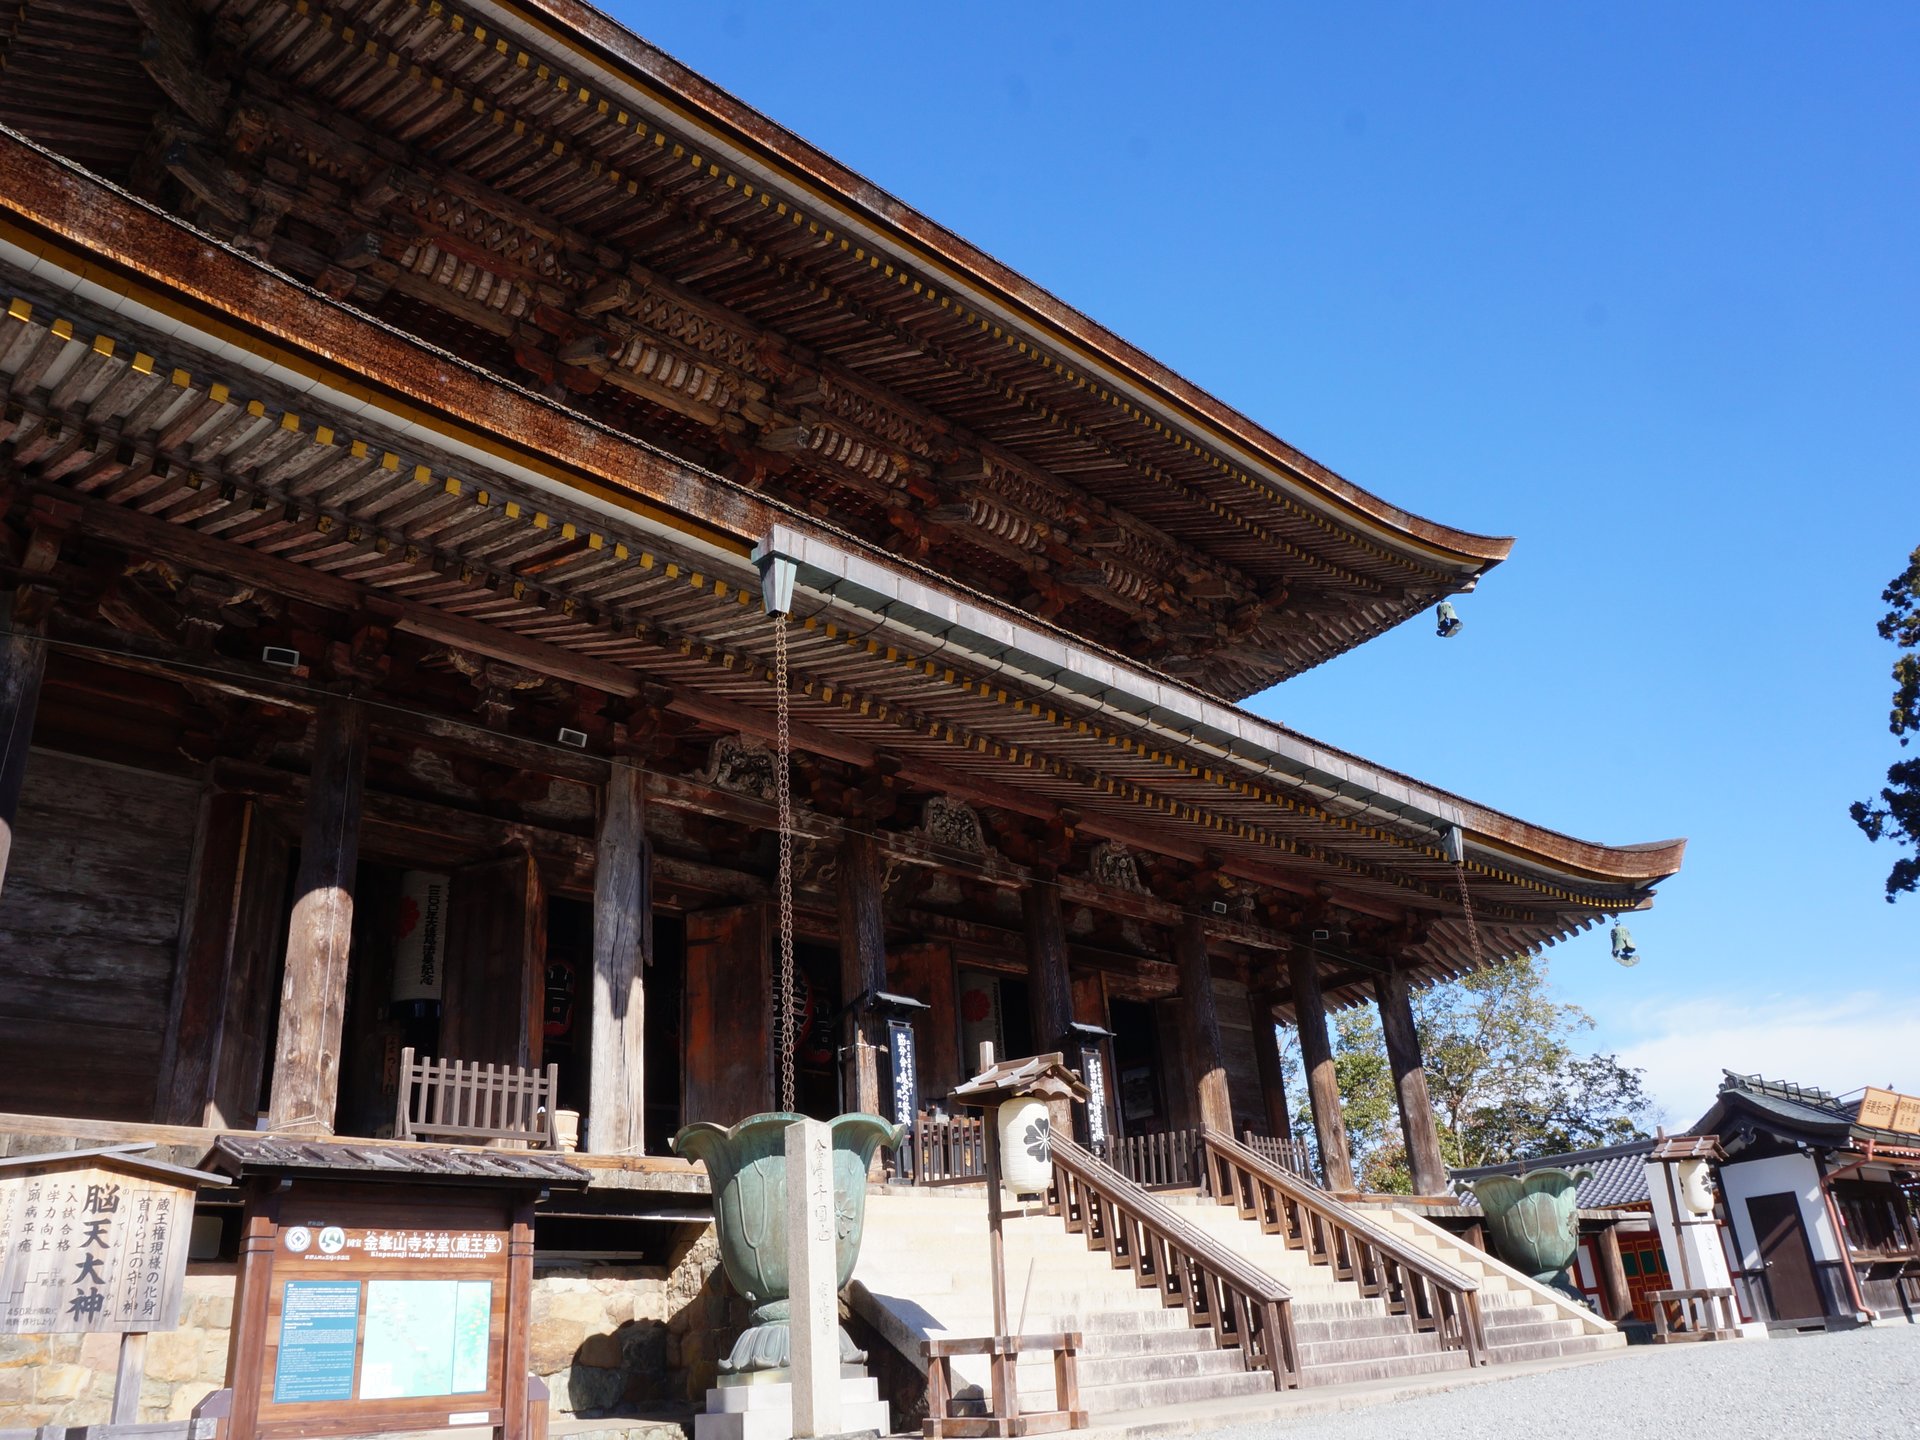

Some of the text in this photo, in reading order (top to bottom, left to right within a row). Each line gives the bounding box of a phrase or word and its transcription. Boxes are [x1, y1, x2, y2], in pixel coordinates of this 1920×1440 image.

[37, 1190, 61, 1252] 学力向上
[56, 1190, 78, 1252] 入試合格
[66, 1183, 121, 1323] 脳天大神
[122, 1197, 152, 1316] 首から上の守り神
[142, 1197, 170, 1316] 蔵王権現様の化身
